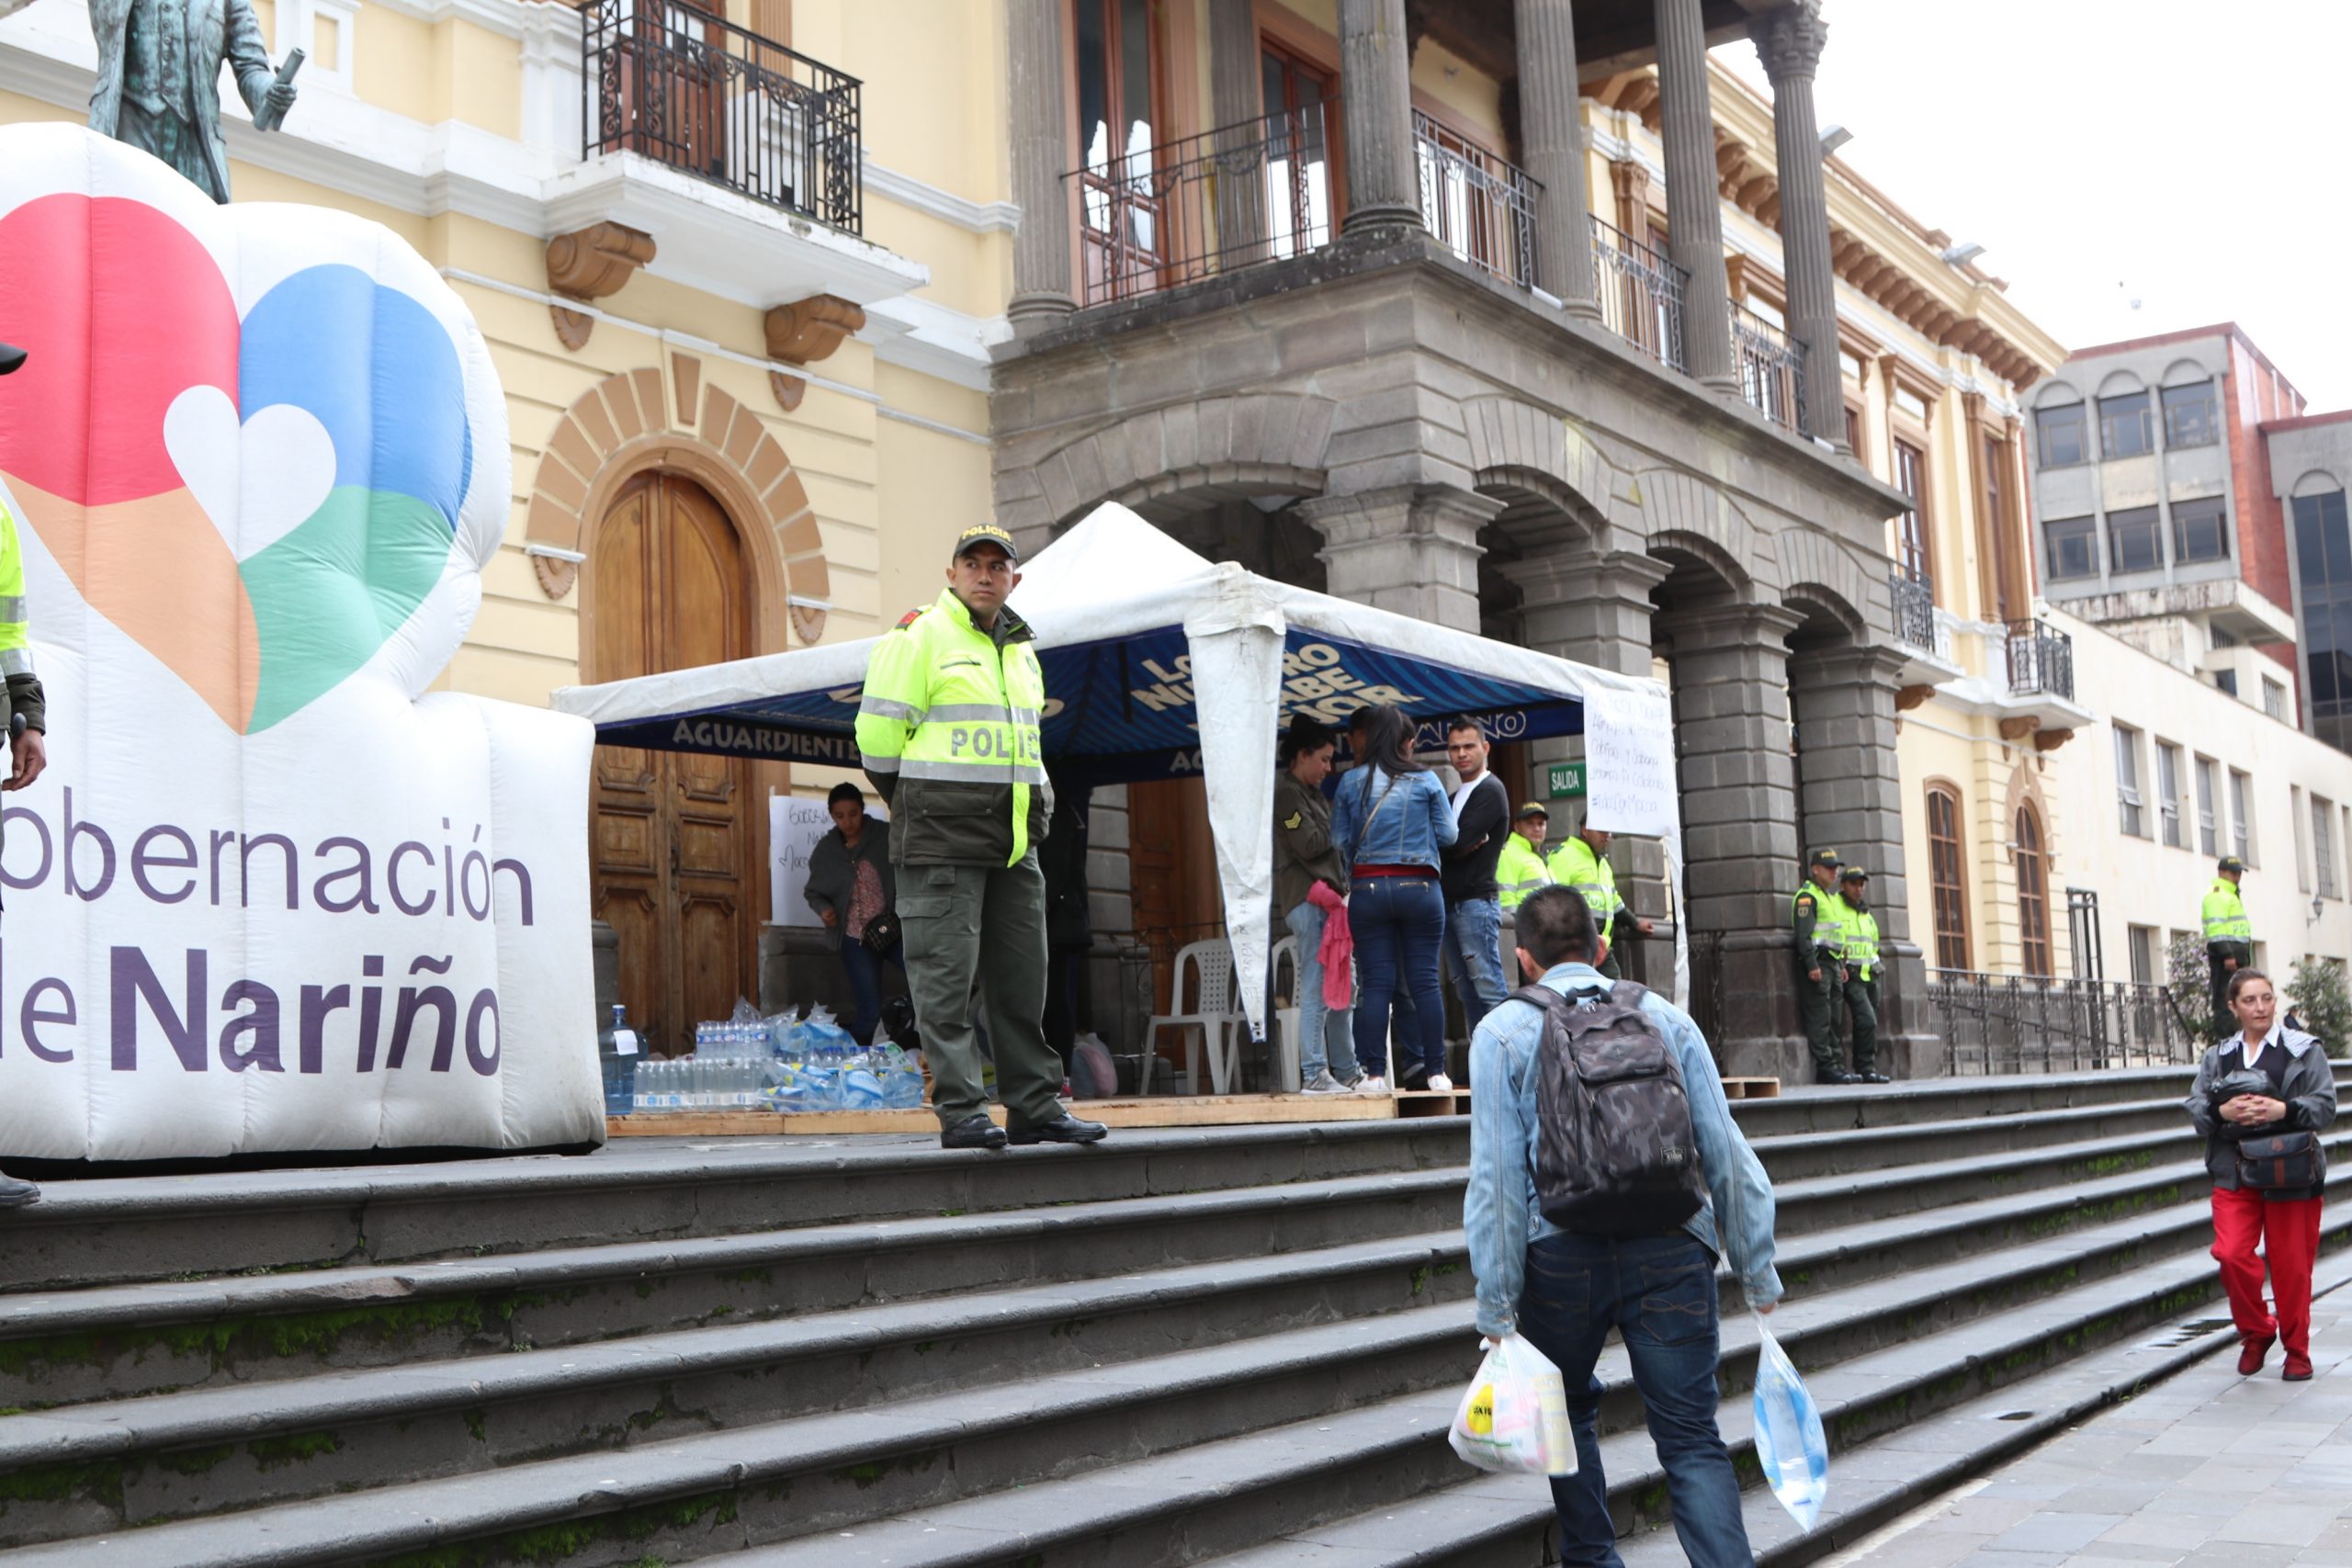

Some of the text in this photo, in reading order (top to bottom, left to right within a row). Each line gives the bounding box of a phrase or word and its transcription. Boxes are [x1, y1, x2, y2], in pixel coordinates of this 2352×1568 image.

[962, 525, 1012, 542] POLICIA
[952, 728, 1040, 761] POLIC
[1551, 770, 1580, 791] SALIDA
[0, 785, 534, 926] obernación
[110, 946, 501, 1077] Nariño
